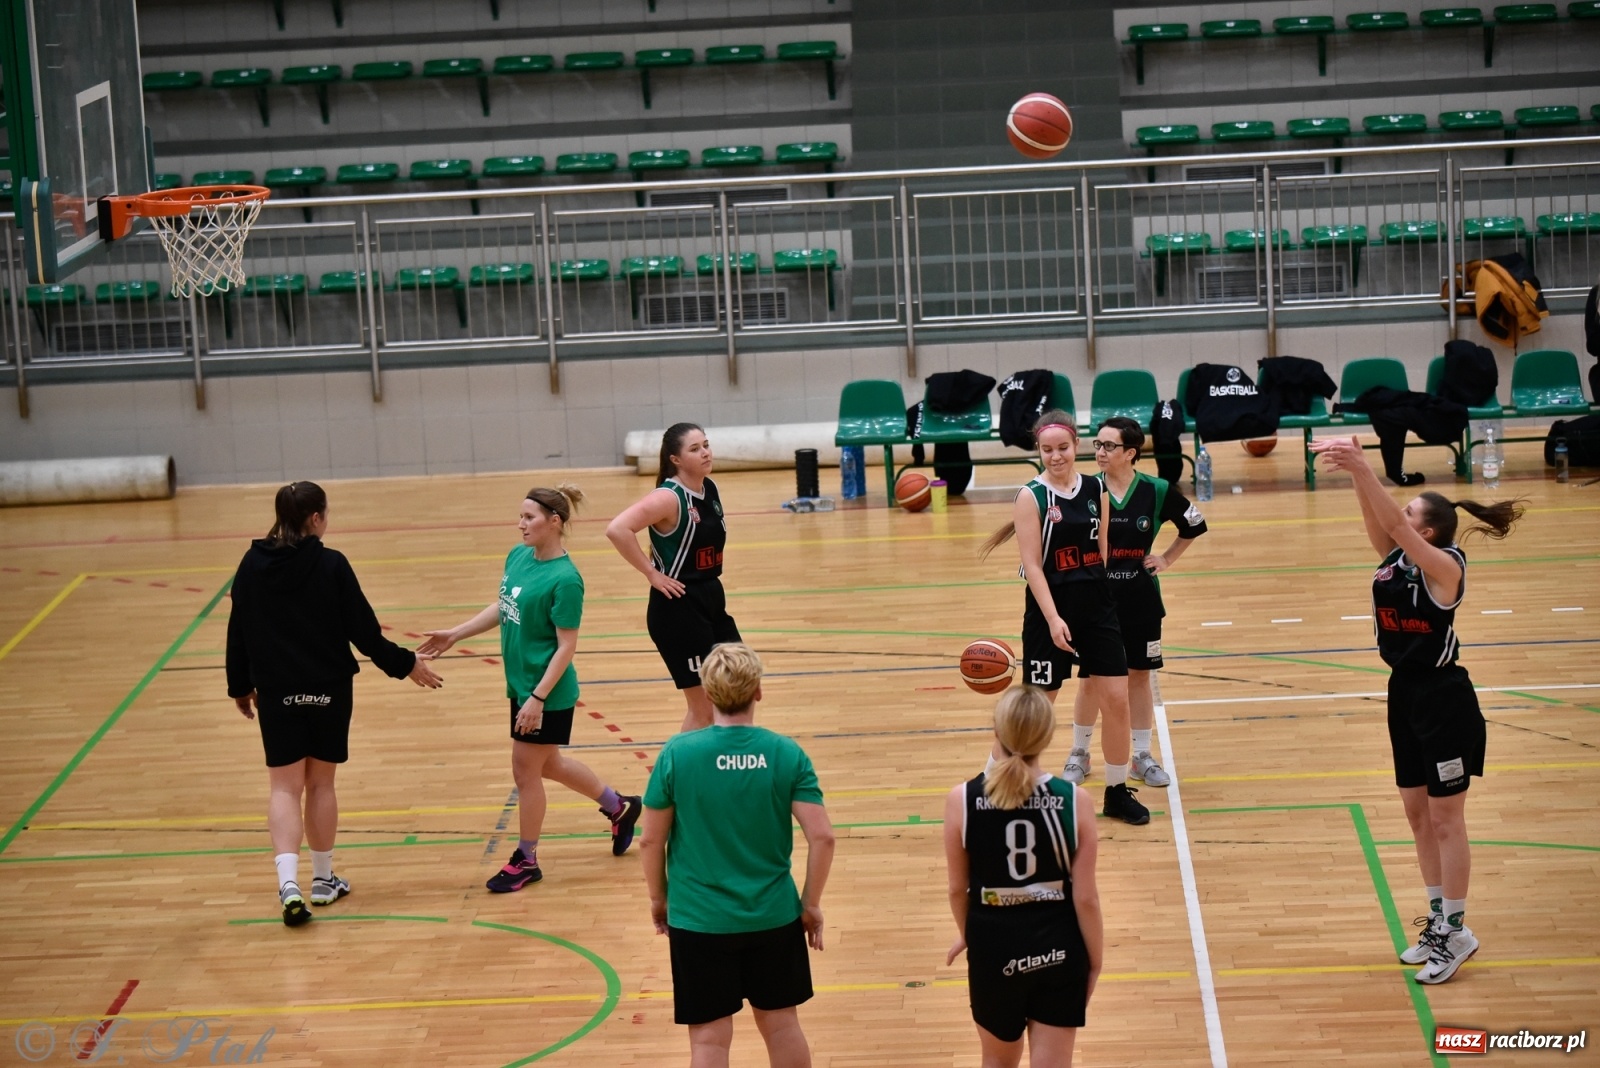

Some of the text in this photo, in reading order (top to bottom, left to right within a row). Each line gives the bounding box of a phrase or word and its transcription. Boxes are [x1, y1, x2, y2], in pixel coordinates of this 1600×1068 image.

[1209, 384, 1258, 397] BASKETBALL
[1089, 517, 1101, 540] 2
[1112, 548, 1145, 559] KAMAN
[1407, 583, 1418, 608] 7
[965, 647, 997, 658] molten
[1030, 659, 1053, 685] 23
[294, 693, 332, 704] Clavis
[716, 753, 768, 771] CHUDA
[1005, 818, 1037, 881] 8
[1017, 948, 1067, 972] Clavis
